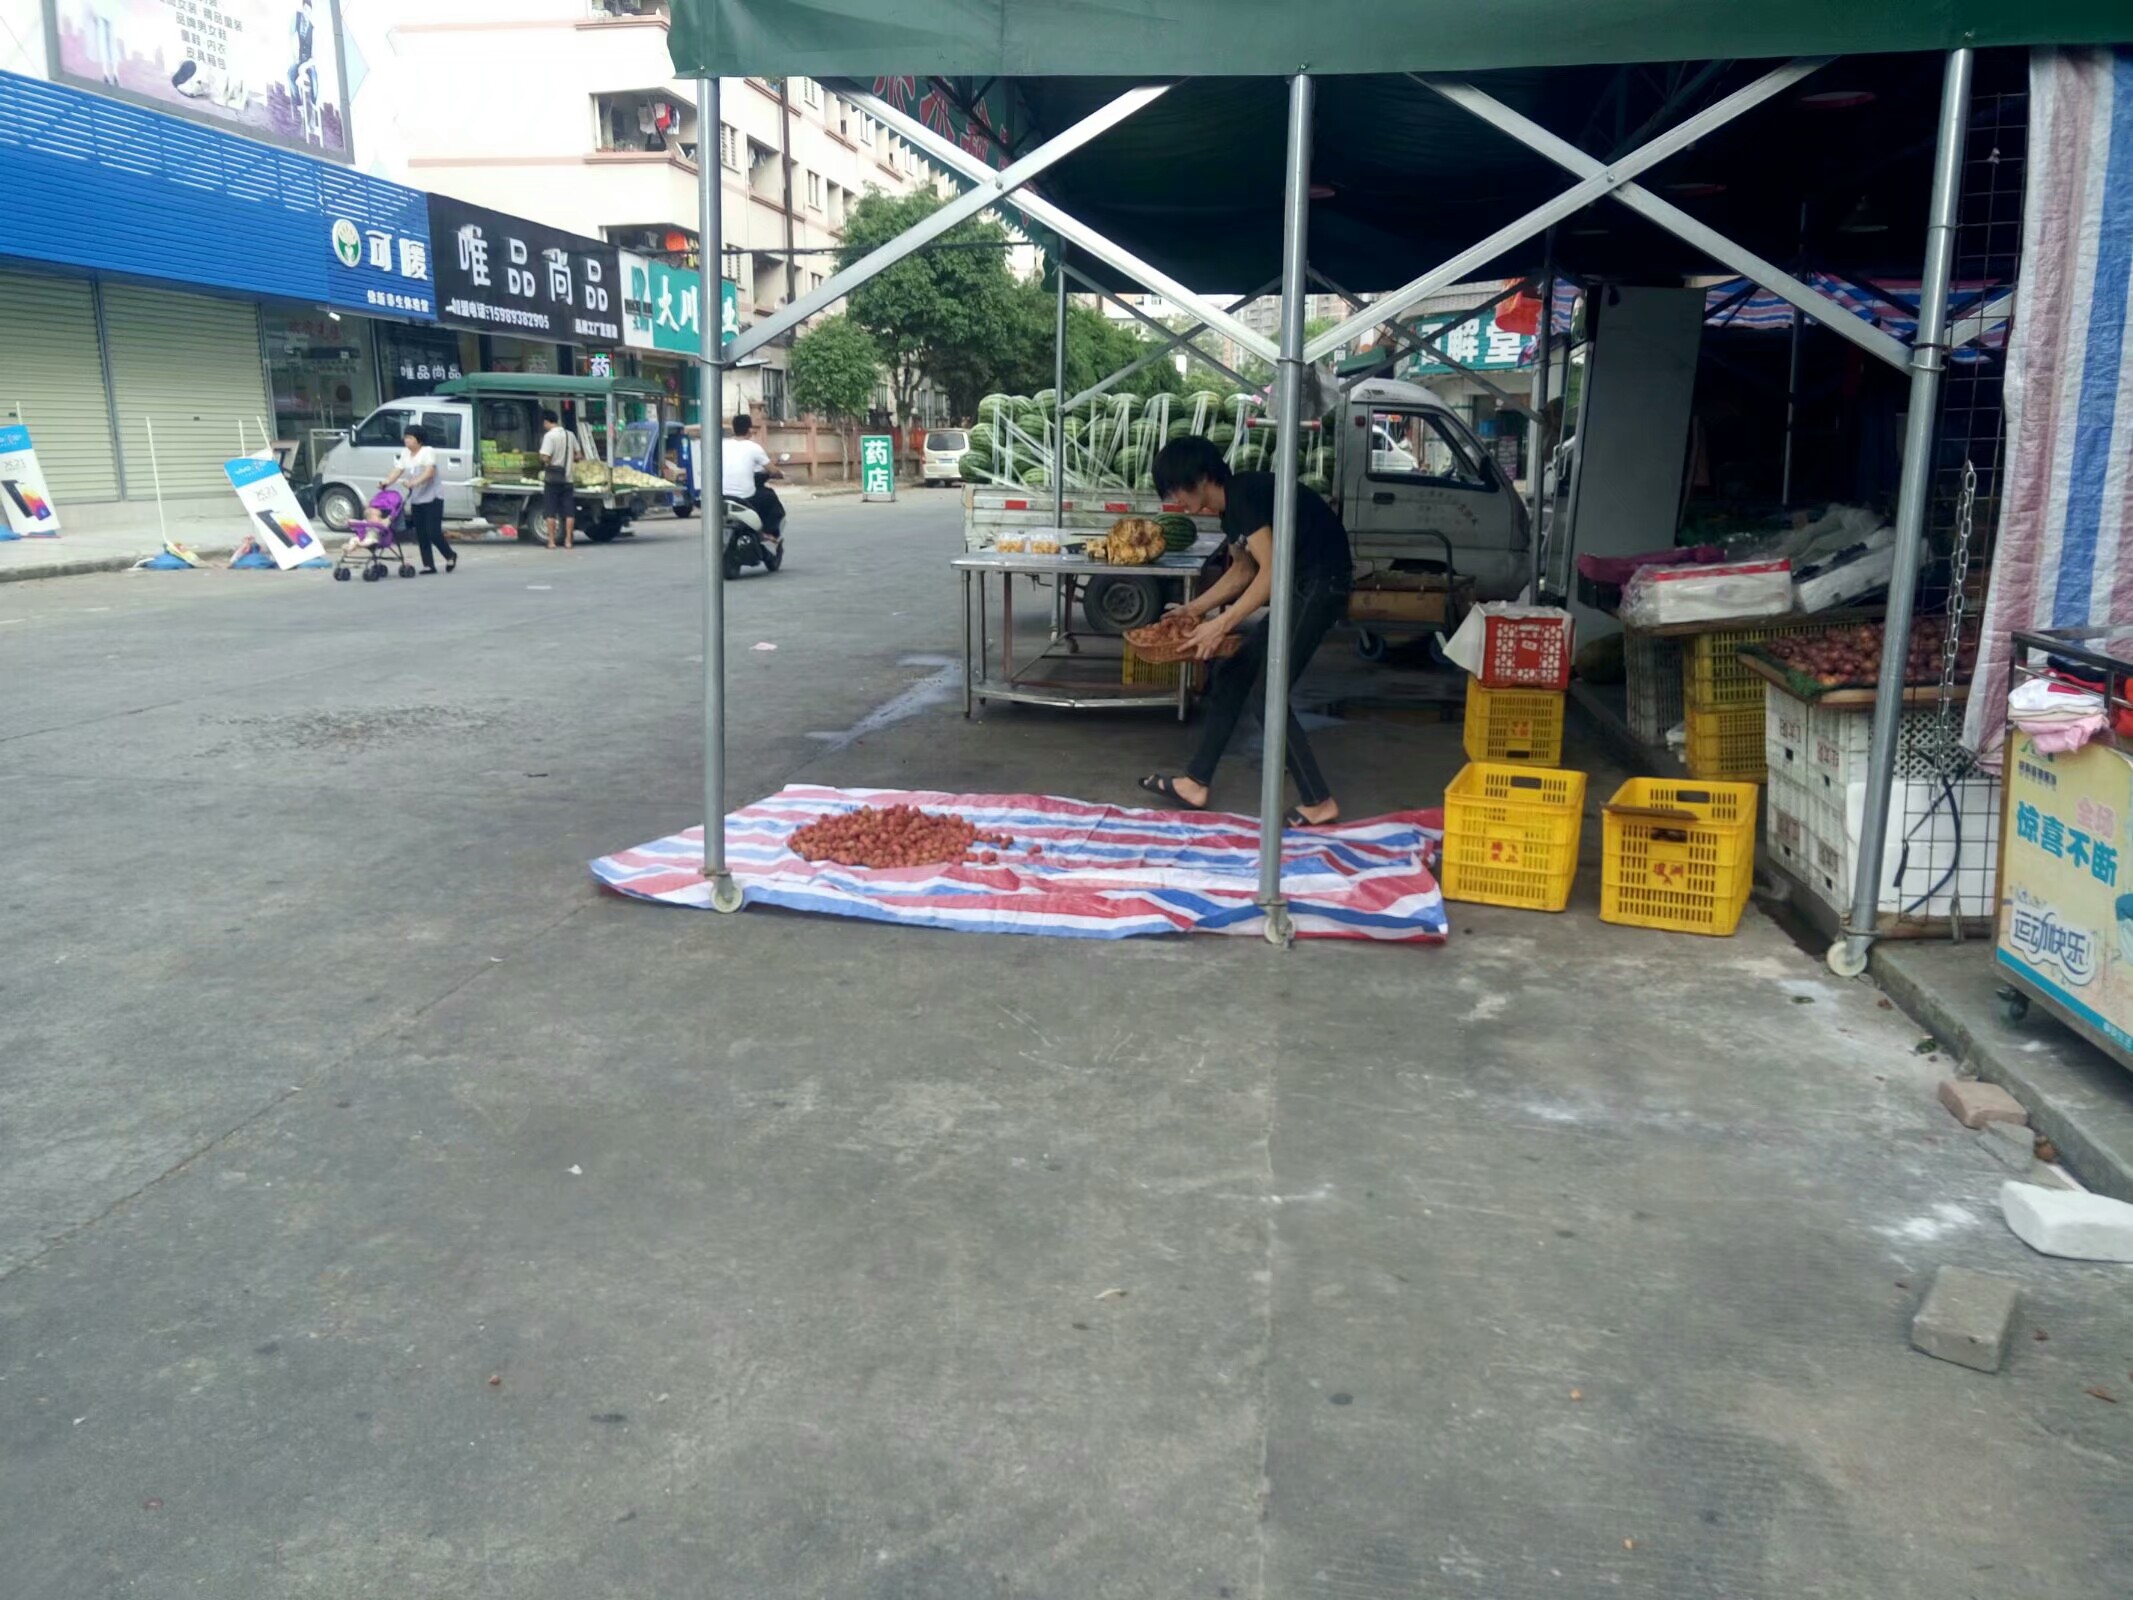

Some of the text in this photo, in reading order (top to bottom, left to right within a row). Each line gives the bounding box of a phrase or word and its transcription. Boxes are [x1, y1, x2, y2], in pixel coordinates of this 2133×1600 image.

[365, 230, 428, 281] 可暖
[457, 224, 609, 312] 唯品尚品
[864, 440, 889, 494] 药店
[2017, 800, 2118, 887] 惊喜不断
